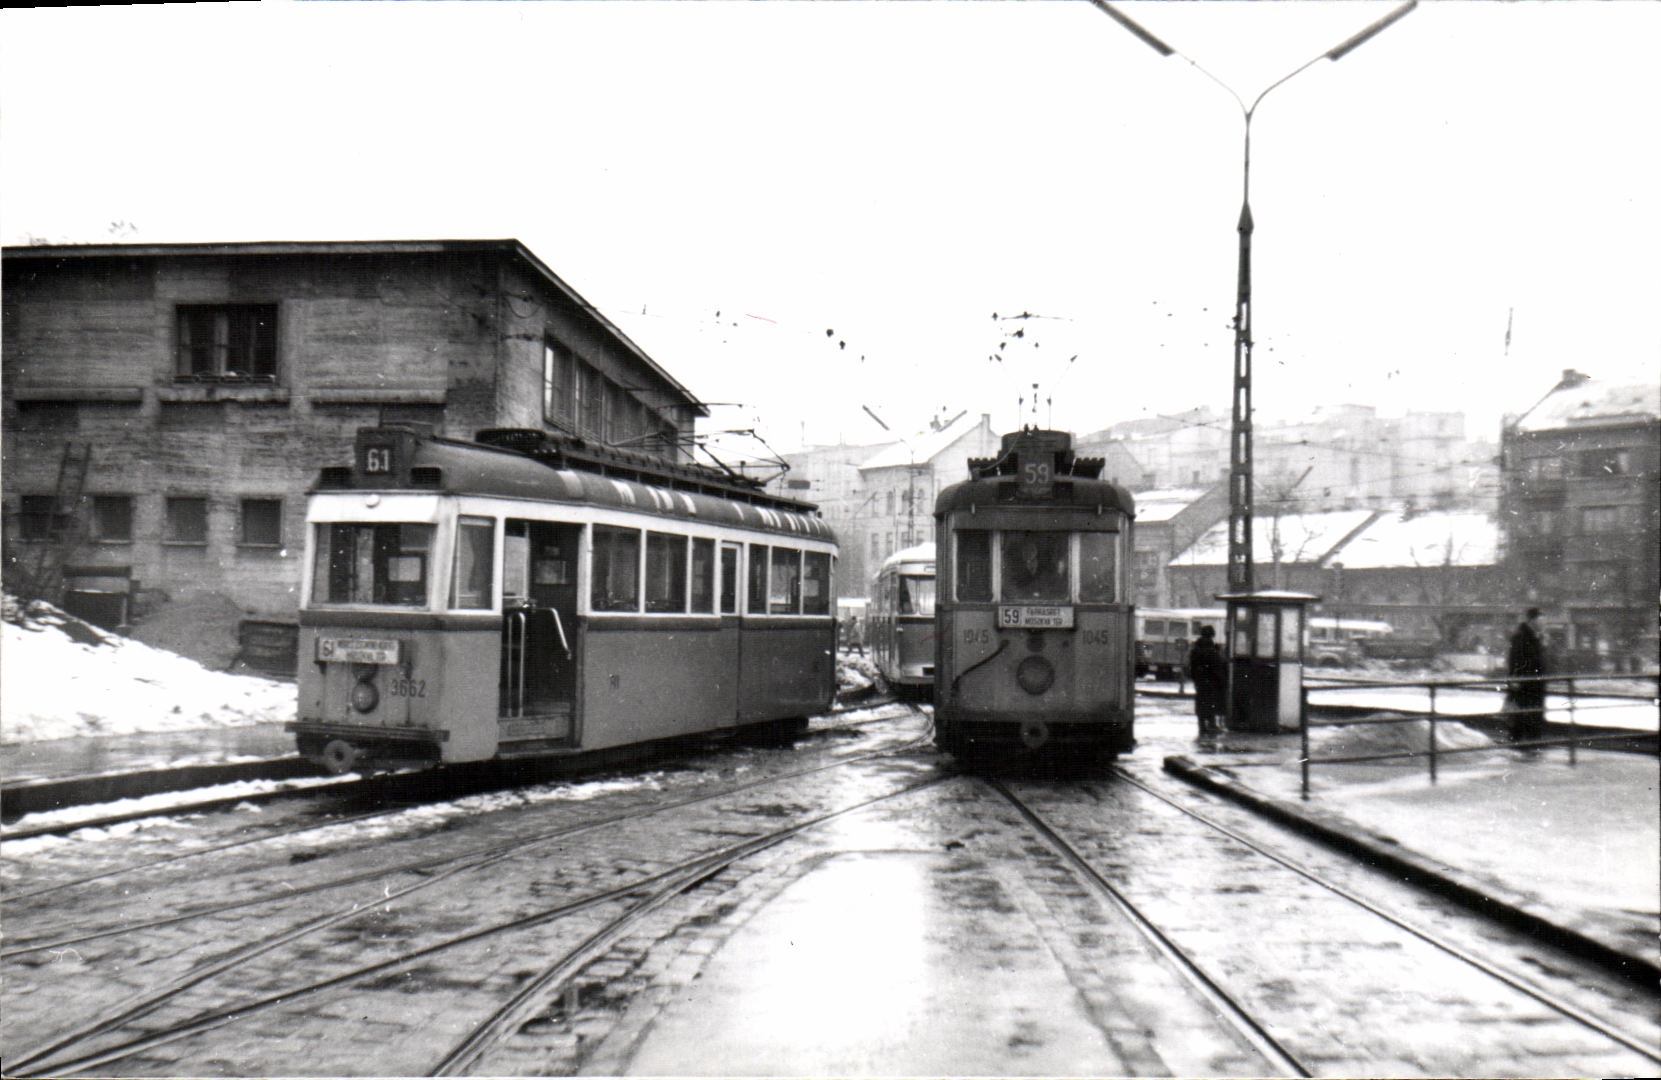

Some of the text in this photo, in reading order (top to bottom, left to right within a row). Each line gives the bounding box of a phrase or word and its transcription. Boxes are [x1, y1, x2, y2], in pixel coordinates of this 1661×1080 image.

[368, 448, 389, 472] 61
[1024, 463, 1049, 484] 59
[1004, 609, 1020, 624] 59
[1082, 629, 1109, 645] 1045
[391, 680, 426, 698] 3662
